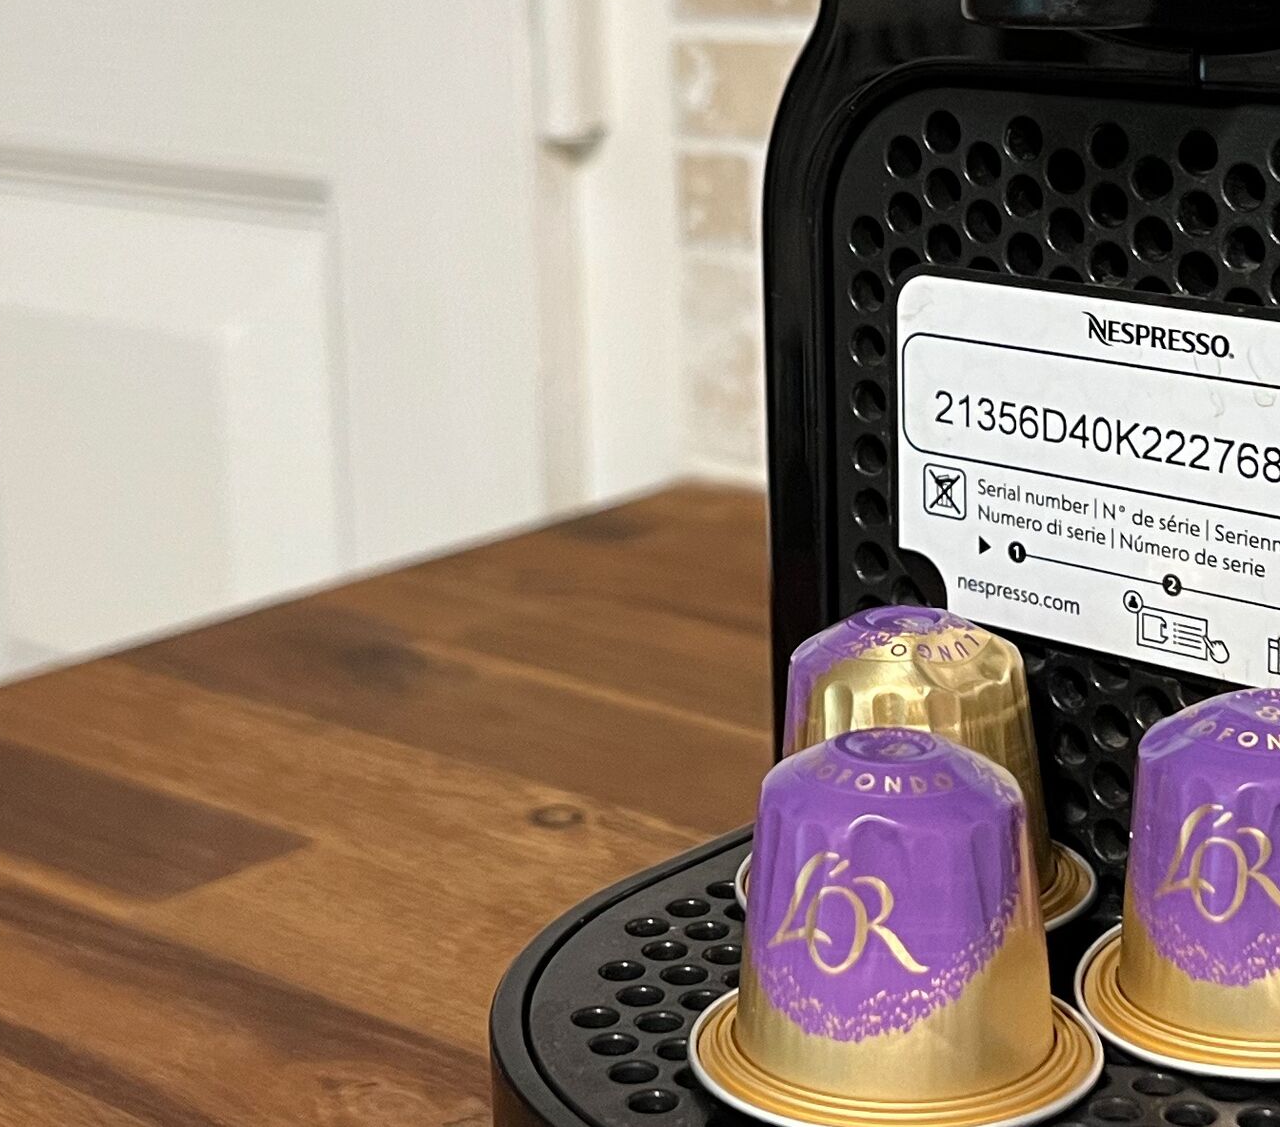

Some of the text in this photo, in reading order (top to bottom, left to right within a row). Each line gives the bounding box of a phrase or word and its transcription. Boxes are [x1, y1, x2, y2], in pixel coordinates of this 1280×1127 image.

[977, 478, 1021, 502] Serial
[1025, 491, 1090, 516] number
[1131, 508, 1155, 529] de
[1158, 515, 1201, 538] série
[977, 504, 1043, 533] Numero
[1046, 519, 1063, 537] di
[1066, 525, 1107, 545] serie
[1119, 531, 1190, 562] Número
[1194, 548, 1218, 568] de
[1222, 558, 1266, 578] serie
[957, 575, 1081, 615] nespresso.com
[890, 632, 980, 662] LUNGO
